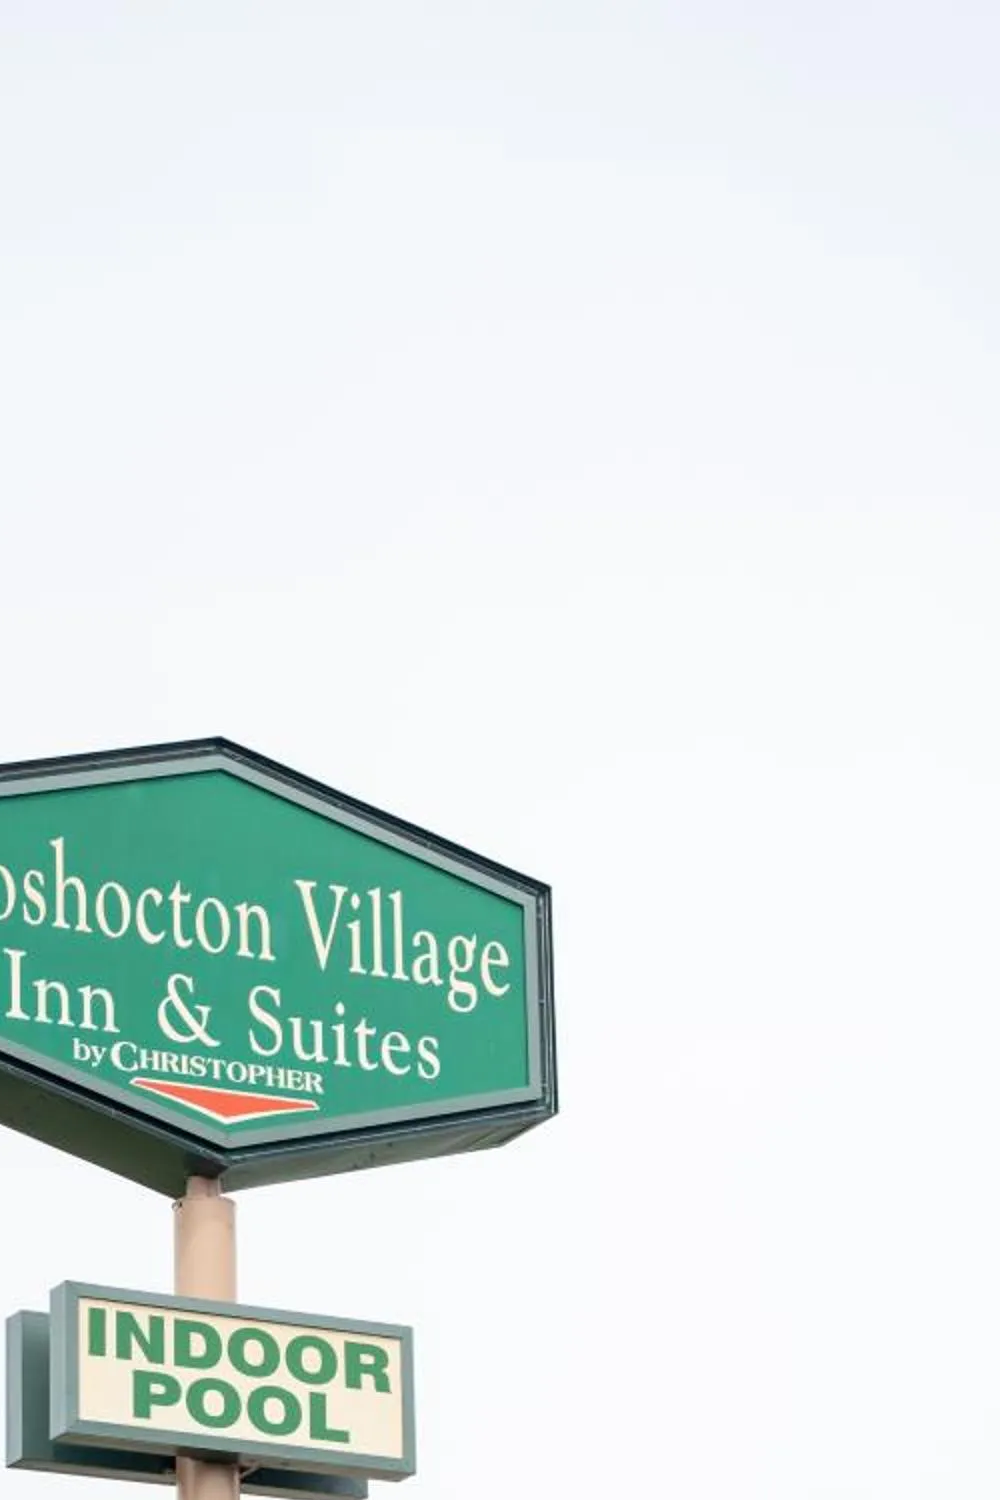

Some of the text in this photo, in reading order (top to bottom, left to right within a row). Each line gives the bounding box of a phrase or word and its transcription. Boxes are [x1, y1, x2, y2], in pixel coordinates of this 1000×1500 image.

[294, 879, 511, 1013] Village
[3, 948, 441, 1080] Inn & Suites
[73, 1038, 324, 1094] by CHRISTOPHER
[88, 1307, 391, 1393] INDOOR
[132, 1369, 350, 1444] POOL
